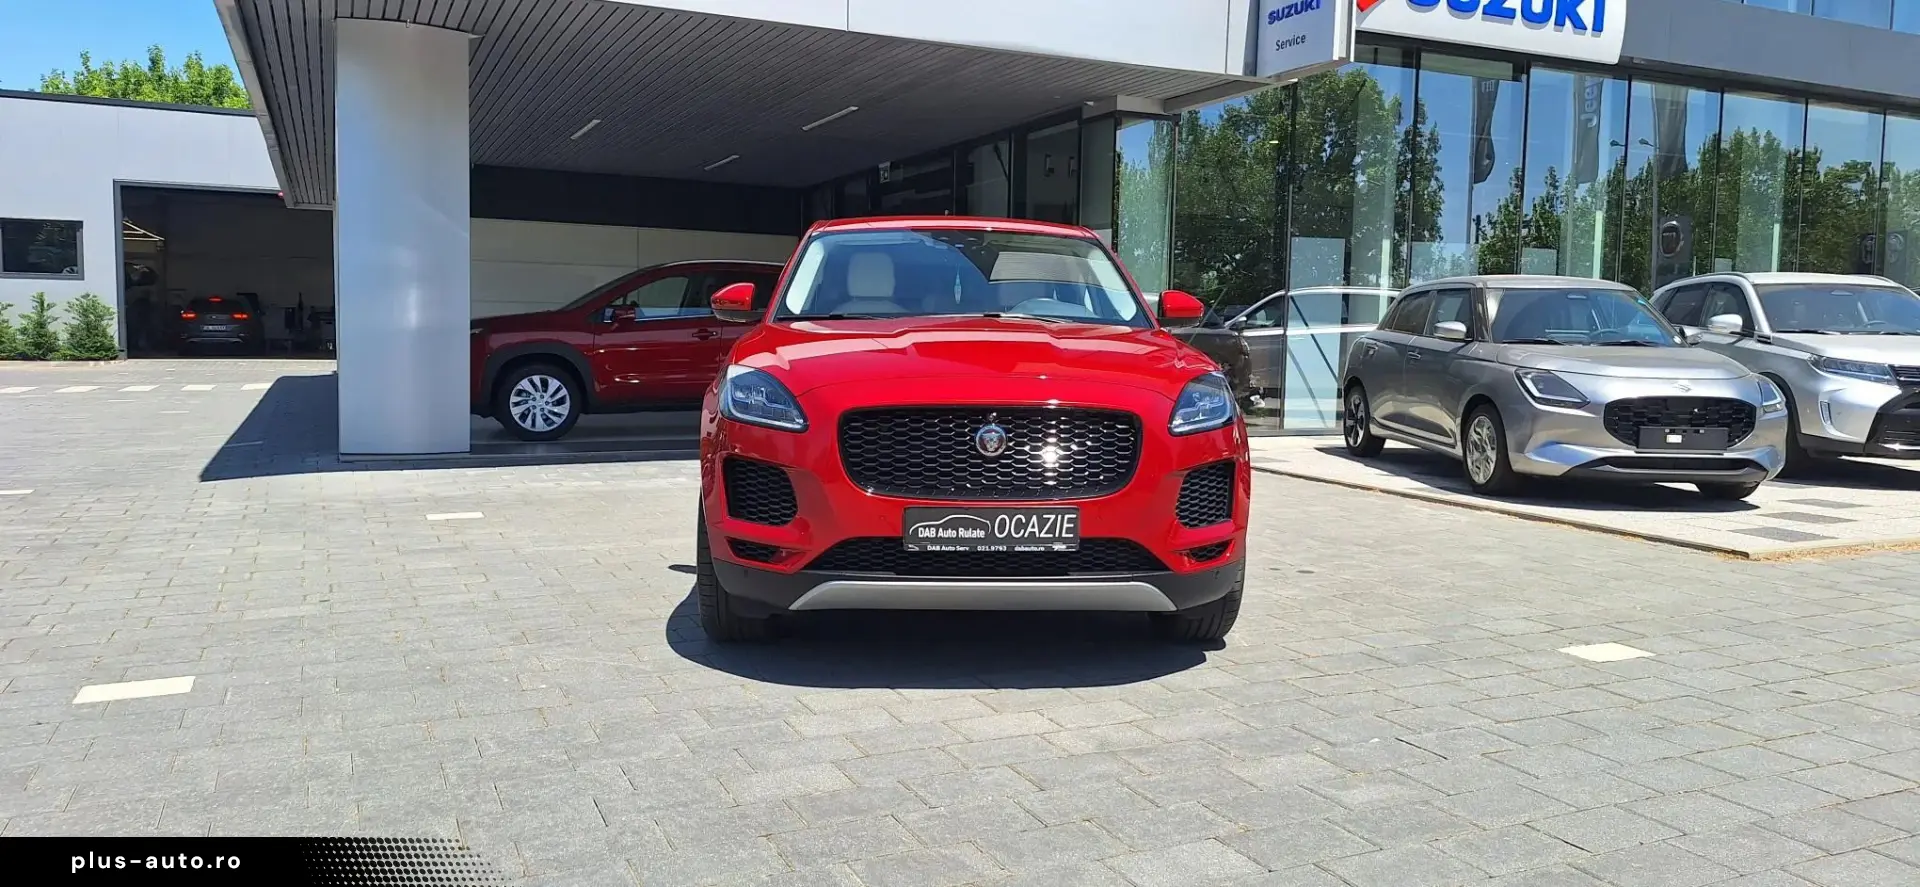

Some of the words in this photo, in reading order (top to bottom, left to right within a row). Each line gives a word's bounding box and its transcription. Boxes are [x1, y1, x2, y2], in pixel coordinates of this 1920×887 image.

[1275, 34, 1306, 51] Service
[918, 527, 936, 538] DAB
[937, 527, 957, 538] Auto
[958, 527, 986, 538] Rulate
[994, 514, 1077, 538] OCAZIE
